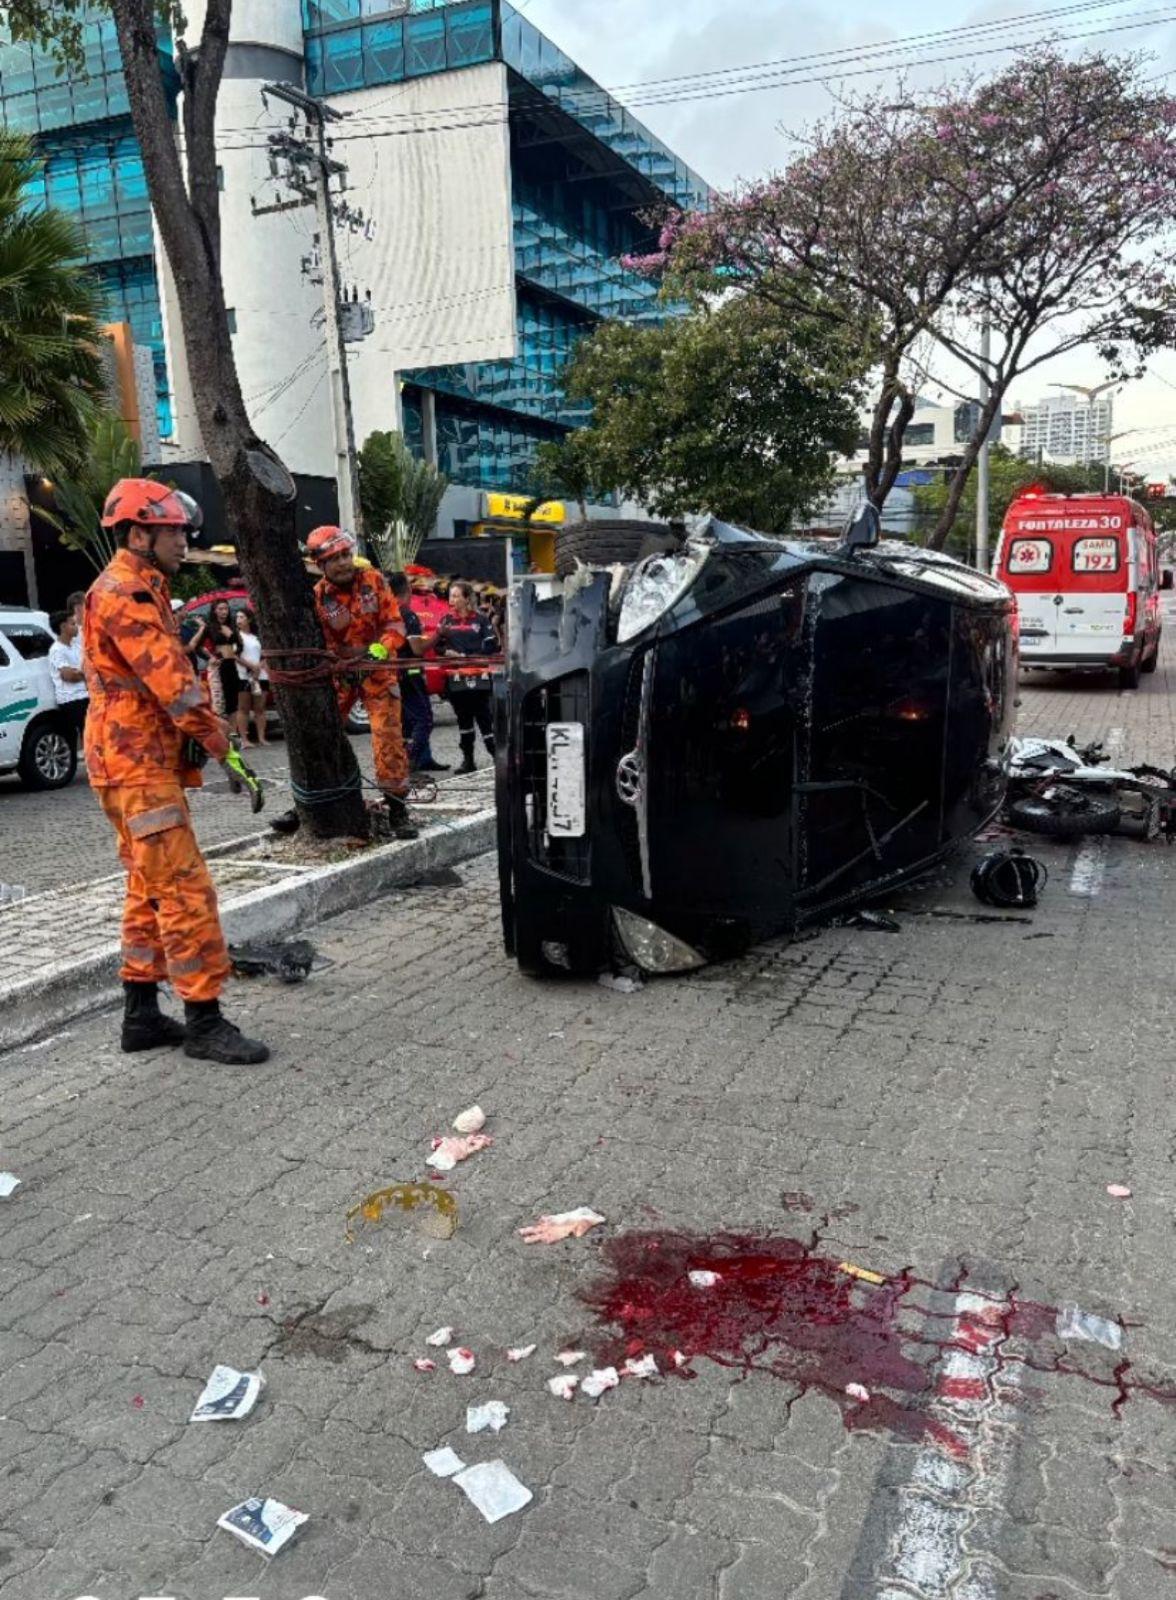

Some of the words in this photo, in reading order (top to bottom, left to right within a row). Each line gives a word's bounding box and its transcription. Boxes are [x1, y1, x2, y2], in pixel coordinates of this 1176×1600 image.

[1018, 519, 1098, 530] FORTALEZA
[1099, 516, 1121, 529] 30
[1083, 540, 1113, 549] SAMU
[1084, 555, 1112, 569] 192
